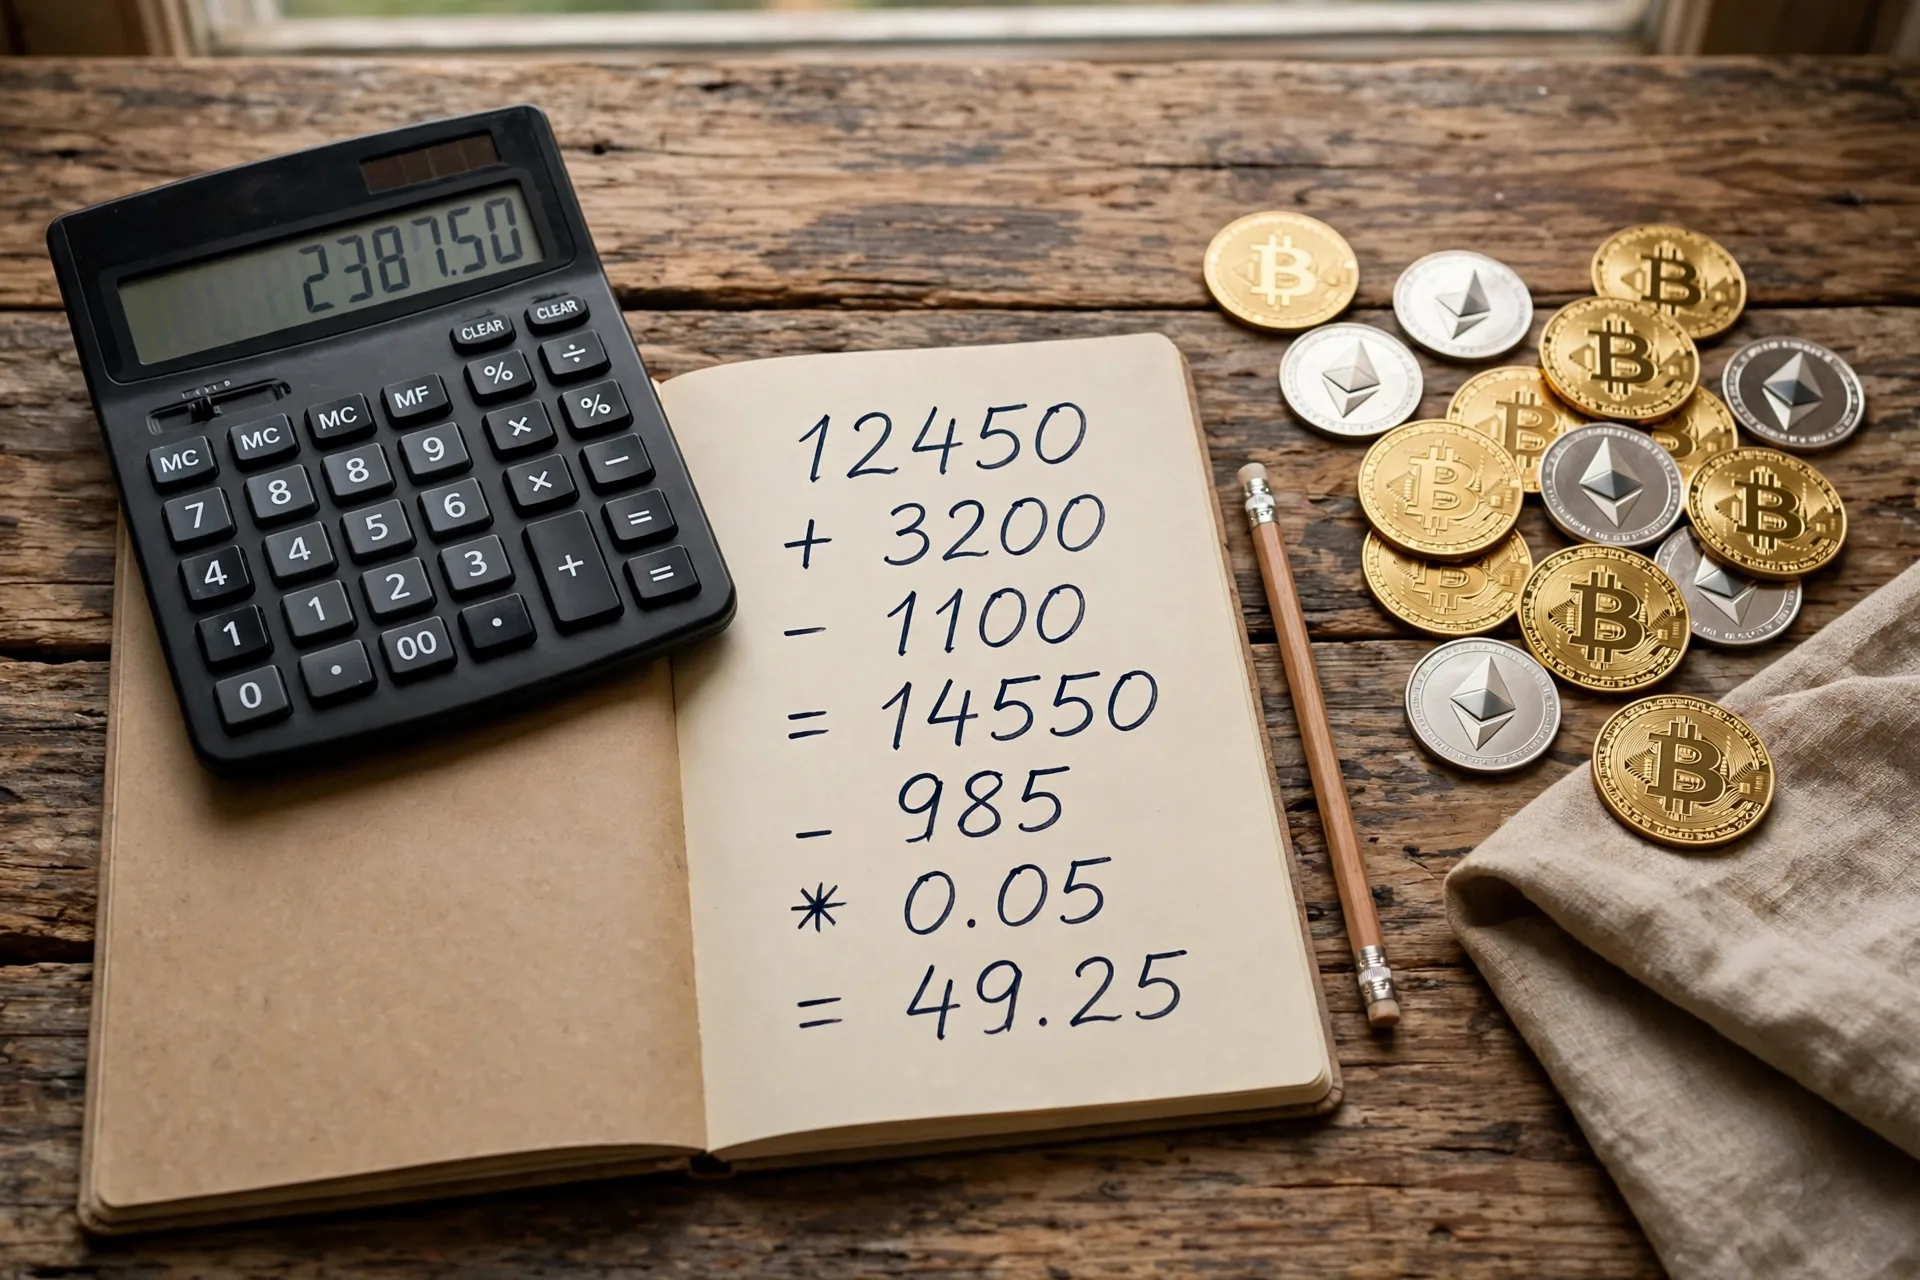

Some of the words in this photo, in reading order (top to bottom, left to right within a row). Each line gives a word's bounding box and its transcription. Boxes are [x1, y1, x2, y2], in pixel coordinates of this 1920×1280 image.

[298, 197, 523, 313] 2387.50
[537, 300, 579, 320] CLEAR
[461, 320, 504, 341] CLEAR
[484, 361, 514, 384] %
[394, 385, 429, 408] MF
[580, 394, 611, 417] %
[318, 406, 358, 430] MC
[240, 427, 281, 451] MC
[422, 437, 445, 461] 9
[799, 402, 1087, 482] 12450
[160, 449, 200, 473] MC
[345, 457, 370, 482] 8
[267, 480, 292, 505] 8
[184, 502, 205, 529] 7
[443, 493, 466, 518] 6
[627, 510, 653, 525] =
[365, 513, 389, 541] 5
[784, 518, 832, 569] +
[884, 494, 1106, 566] 3200
[288, 536, 312, 562] 4
[203, 559, 228, 586] 4
[463, 550, 488, 577] 3
[558, 554, 584, 577] +
[649, 565, 675, 582] =
[385, 573, 411, 600] 2
[307, 596, 327, 621] 1
[887, 584, 1086, 657] 1100
[222, 621, 242, 646] 1
[396, 629, 437, 660] 00
[239, 682, 262, 709] 0
[788, 710, 829, 740] =
[882, 670, 1159, 750] 14550
[899, 766, 1071, 843] 985
[904, 857, 1112, 936] 0.05
[797, 997, 843, 1029] =
[907, 950, 1188, 1041] 49.25
